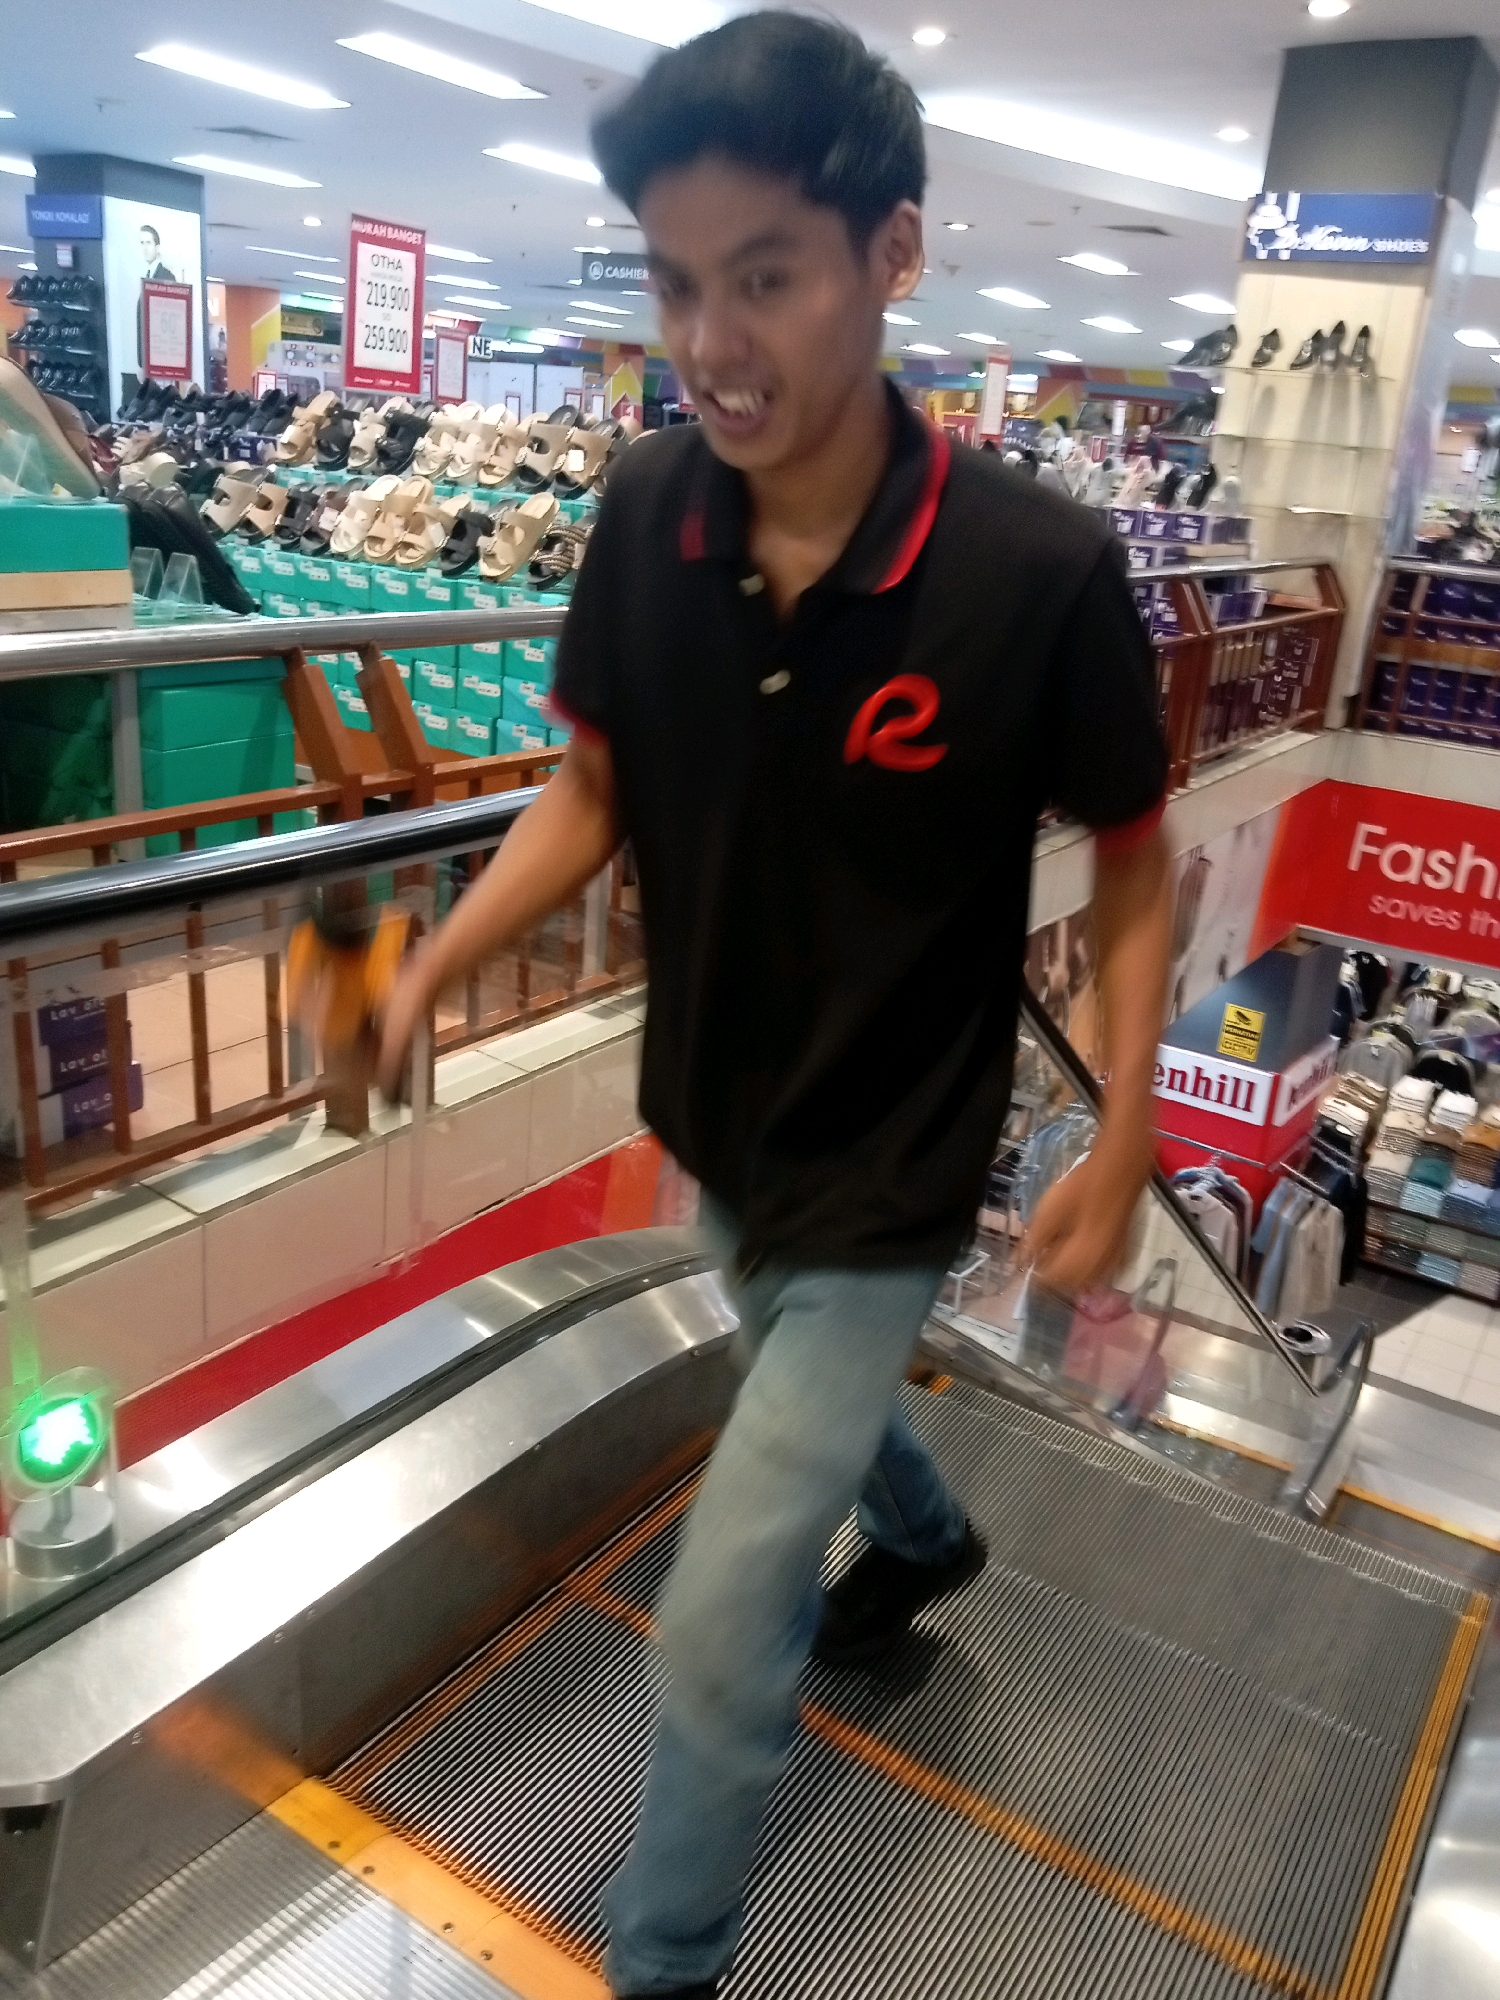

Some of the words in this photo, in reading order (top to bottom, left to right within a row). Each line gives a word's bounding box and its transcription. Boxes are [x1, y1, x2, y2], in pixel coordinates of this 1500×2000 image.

[387, 226, 423, 245] BANGET
[371, 254, 403, 270] OTHA
[605, 266, 650, 280] CASHIER
[366, 281, 410, 311] 219.900
[364, 324, 408, 353] 259.900
[472, 337, 491, 356] NE
[1347, 821, 1500, 900] Fash
[1368, 894, 1463, 931] saves
